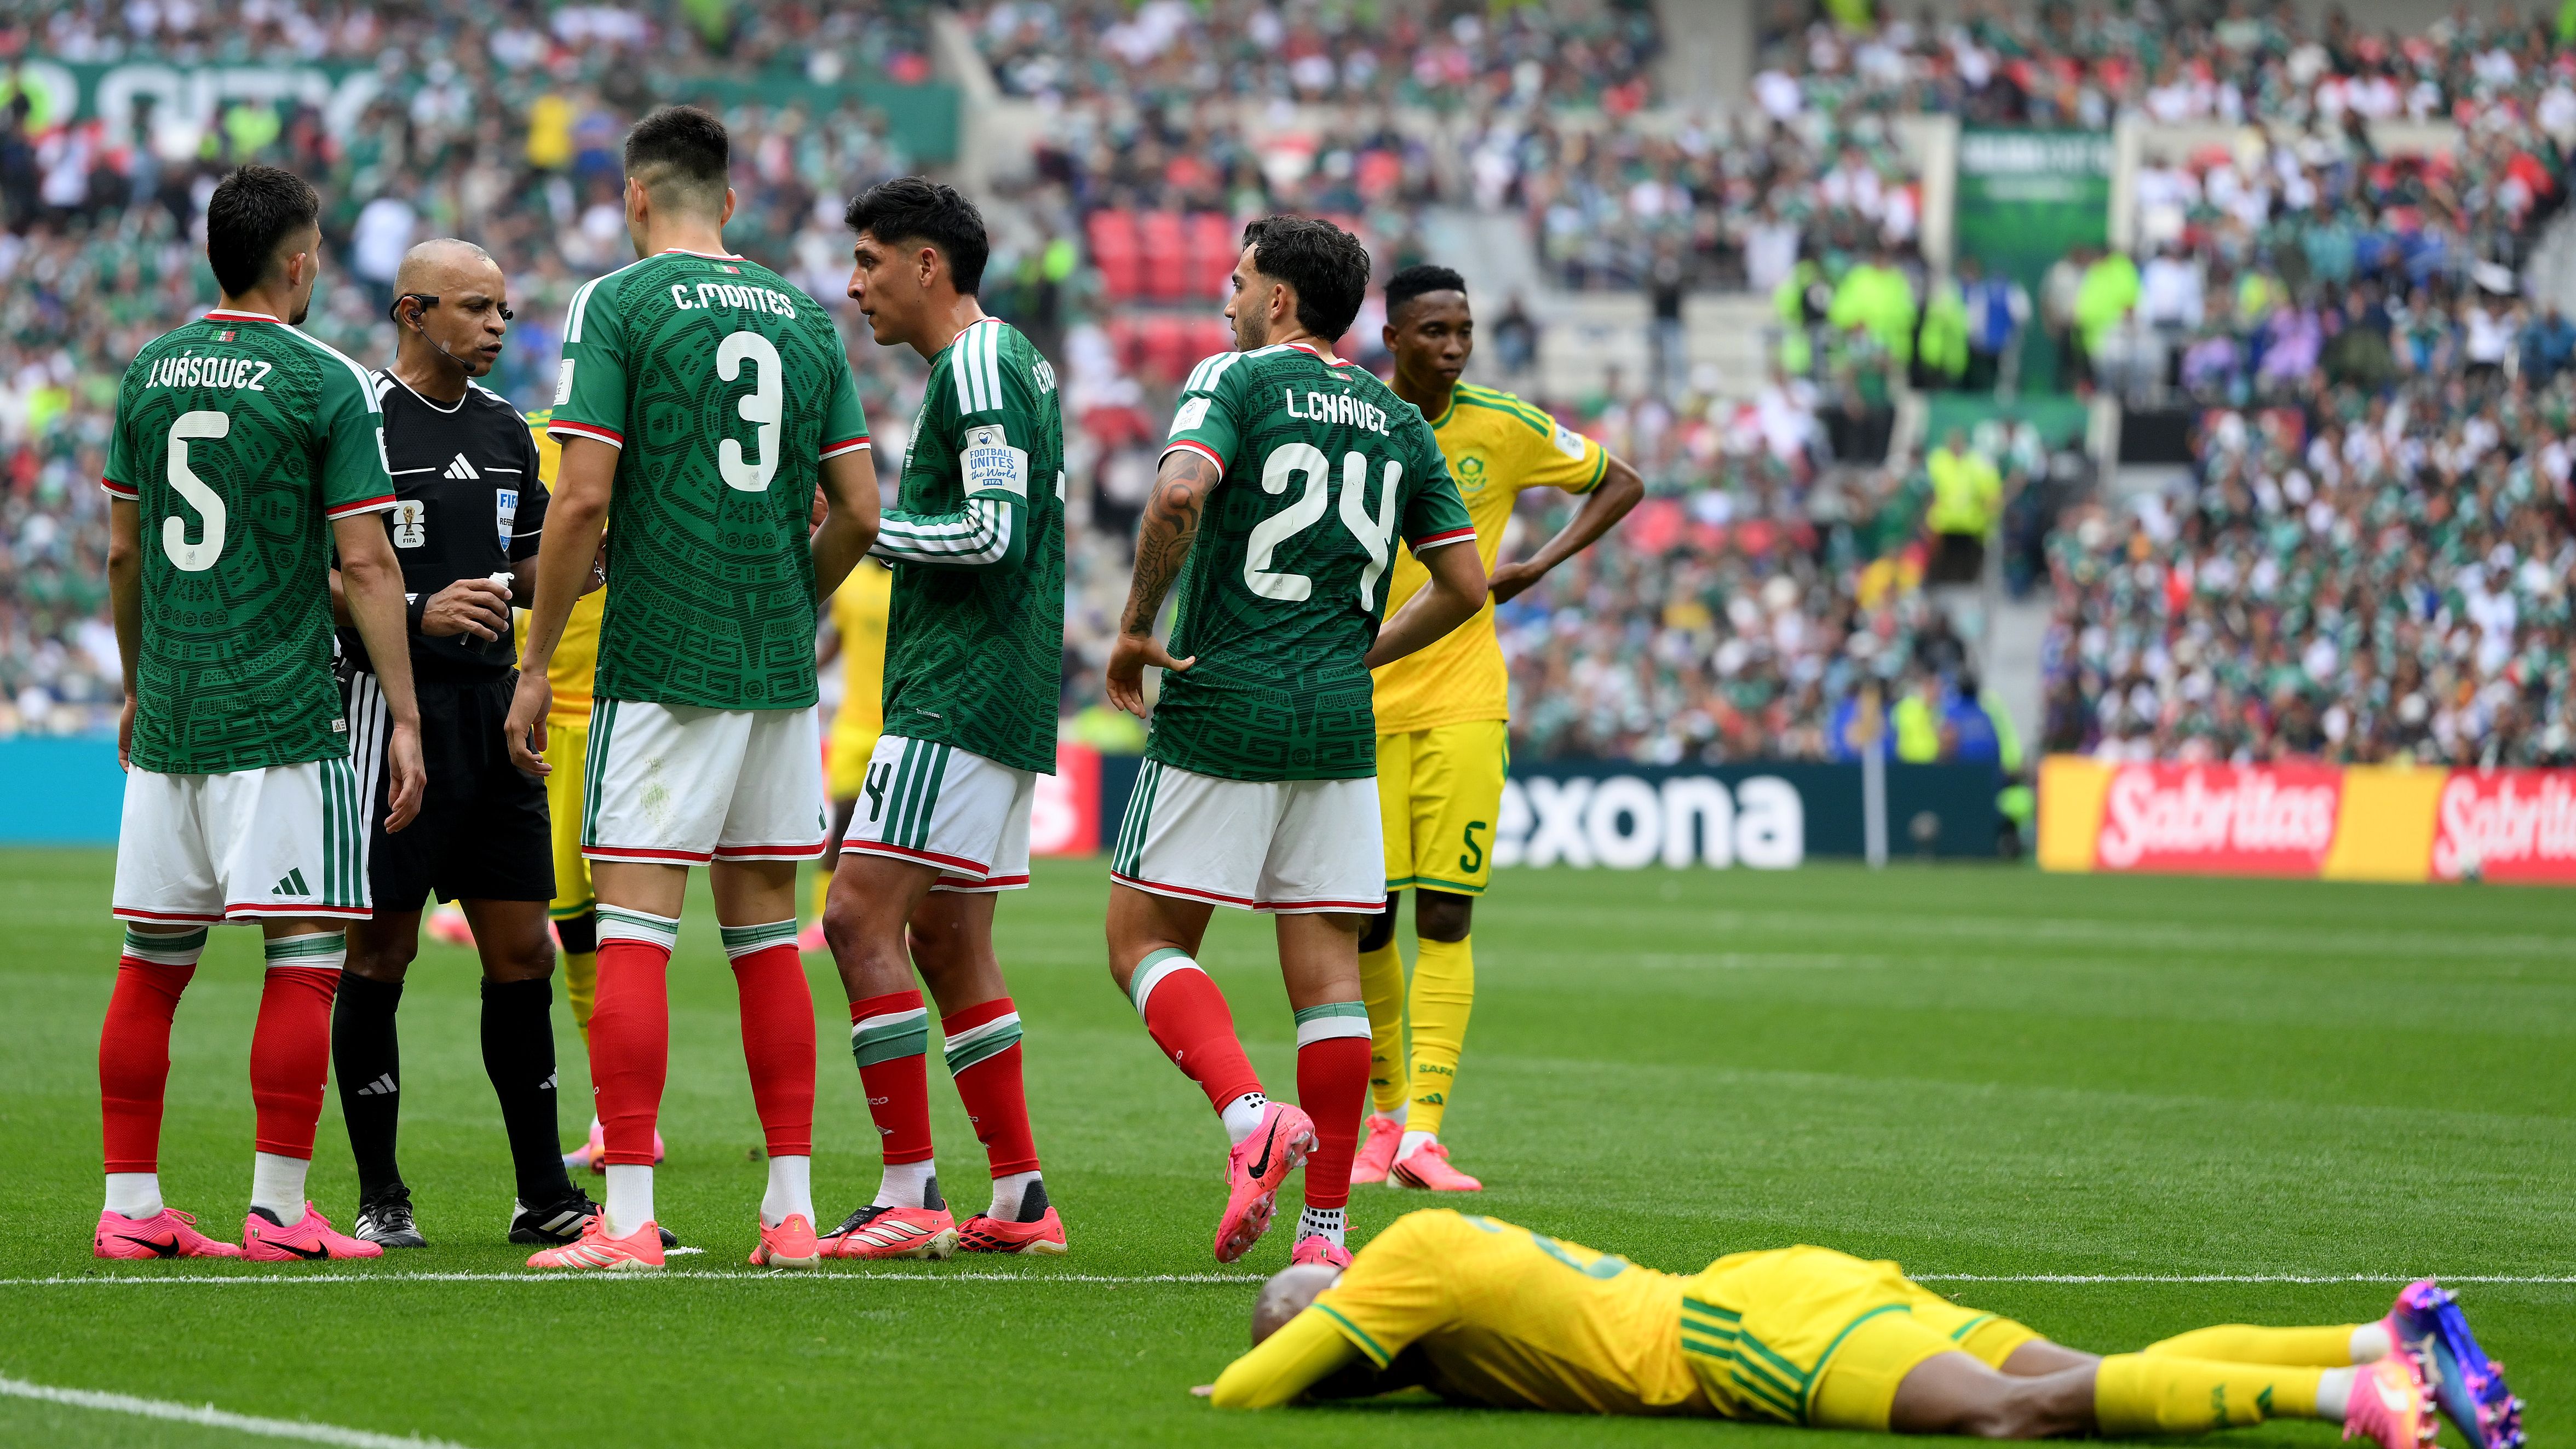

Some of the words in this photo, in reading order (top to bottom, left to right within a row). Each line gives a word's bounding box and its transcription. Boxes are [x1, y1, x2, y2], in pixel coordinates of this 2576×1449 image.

[670, 283, 796, 319] C.MONTES
[146, 350, 272, 391] J.VÁSQUEZ
[716, 331, 783, 492] 3
[1286, 387, 1390, 437] L.CHÁVEZ
[969, 448, 1014, 459] FOOTBALL
[970, 456, 1014, 469] UNITES
[970, 469, 985, 480] the
[986, 468, 1017, 481] World
[162, 411, 229, 572] 5
[1243, 442, 1403, 612] 24
[865, 762, 892, 823] 4
[2098, 763, 2336, 869] Sabritas
[1459, 820, 1487, 873] 5
[1491, 774, 1805, 870] exona
[2433, 774, 2576, 878] Sabrit
